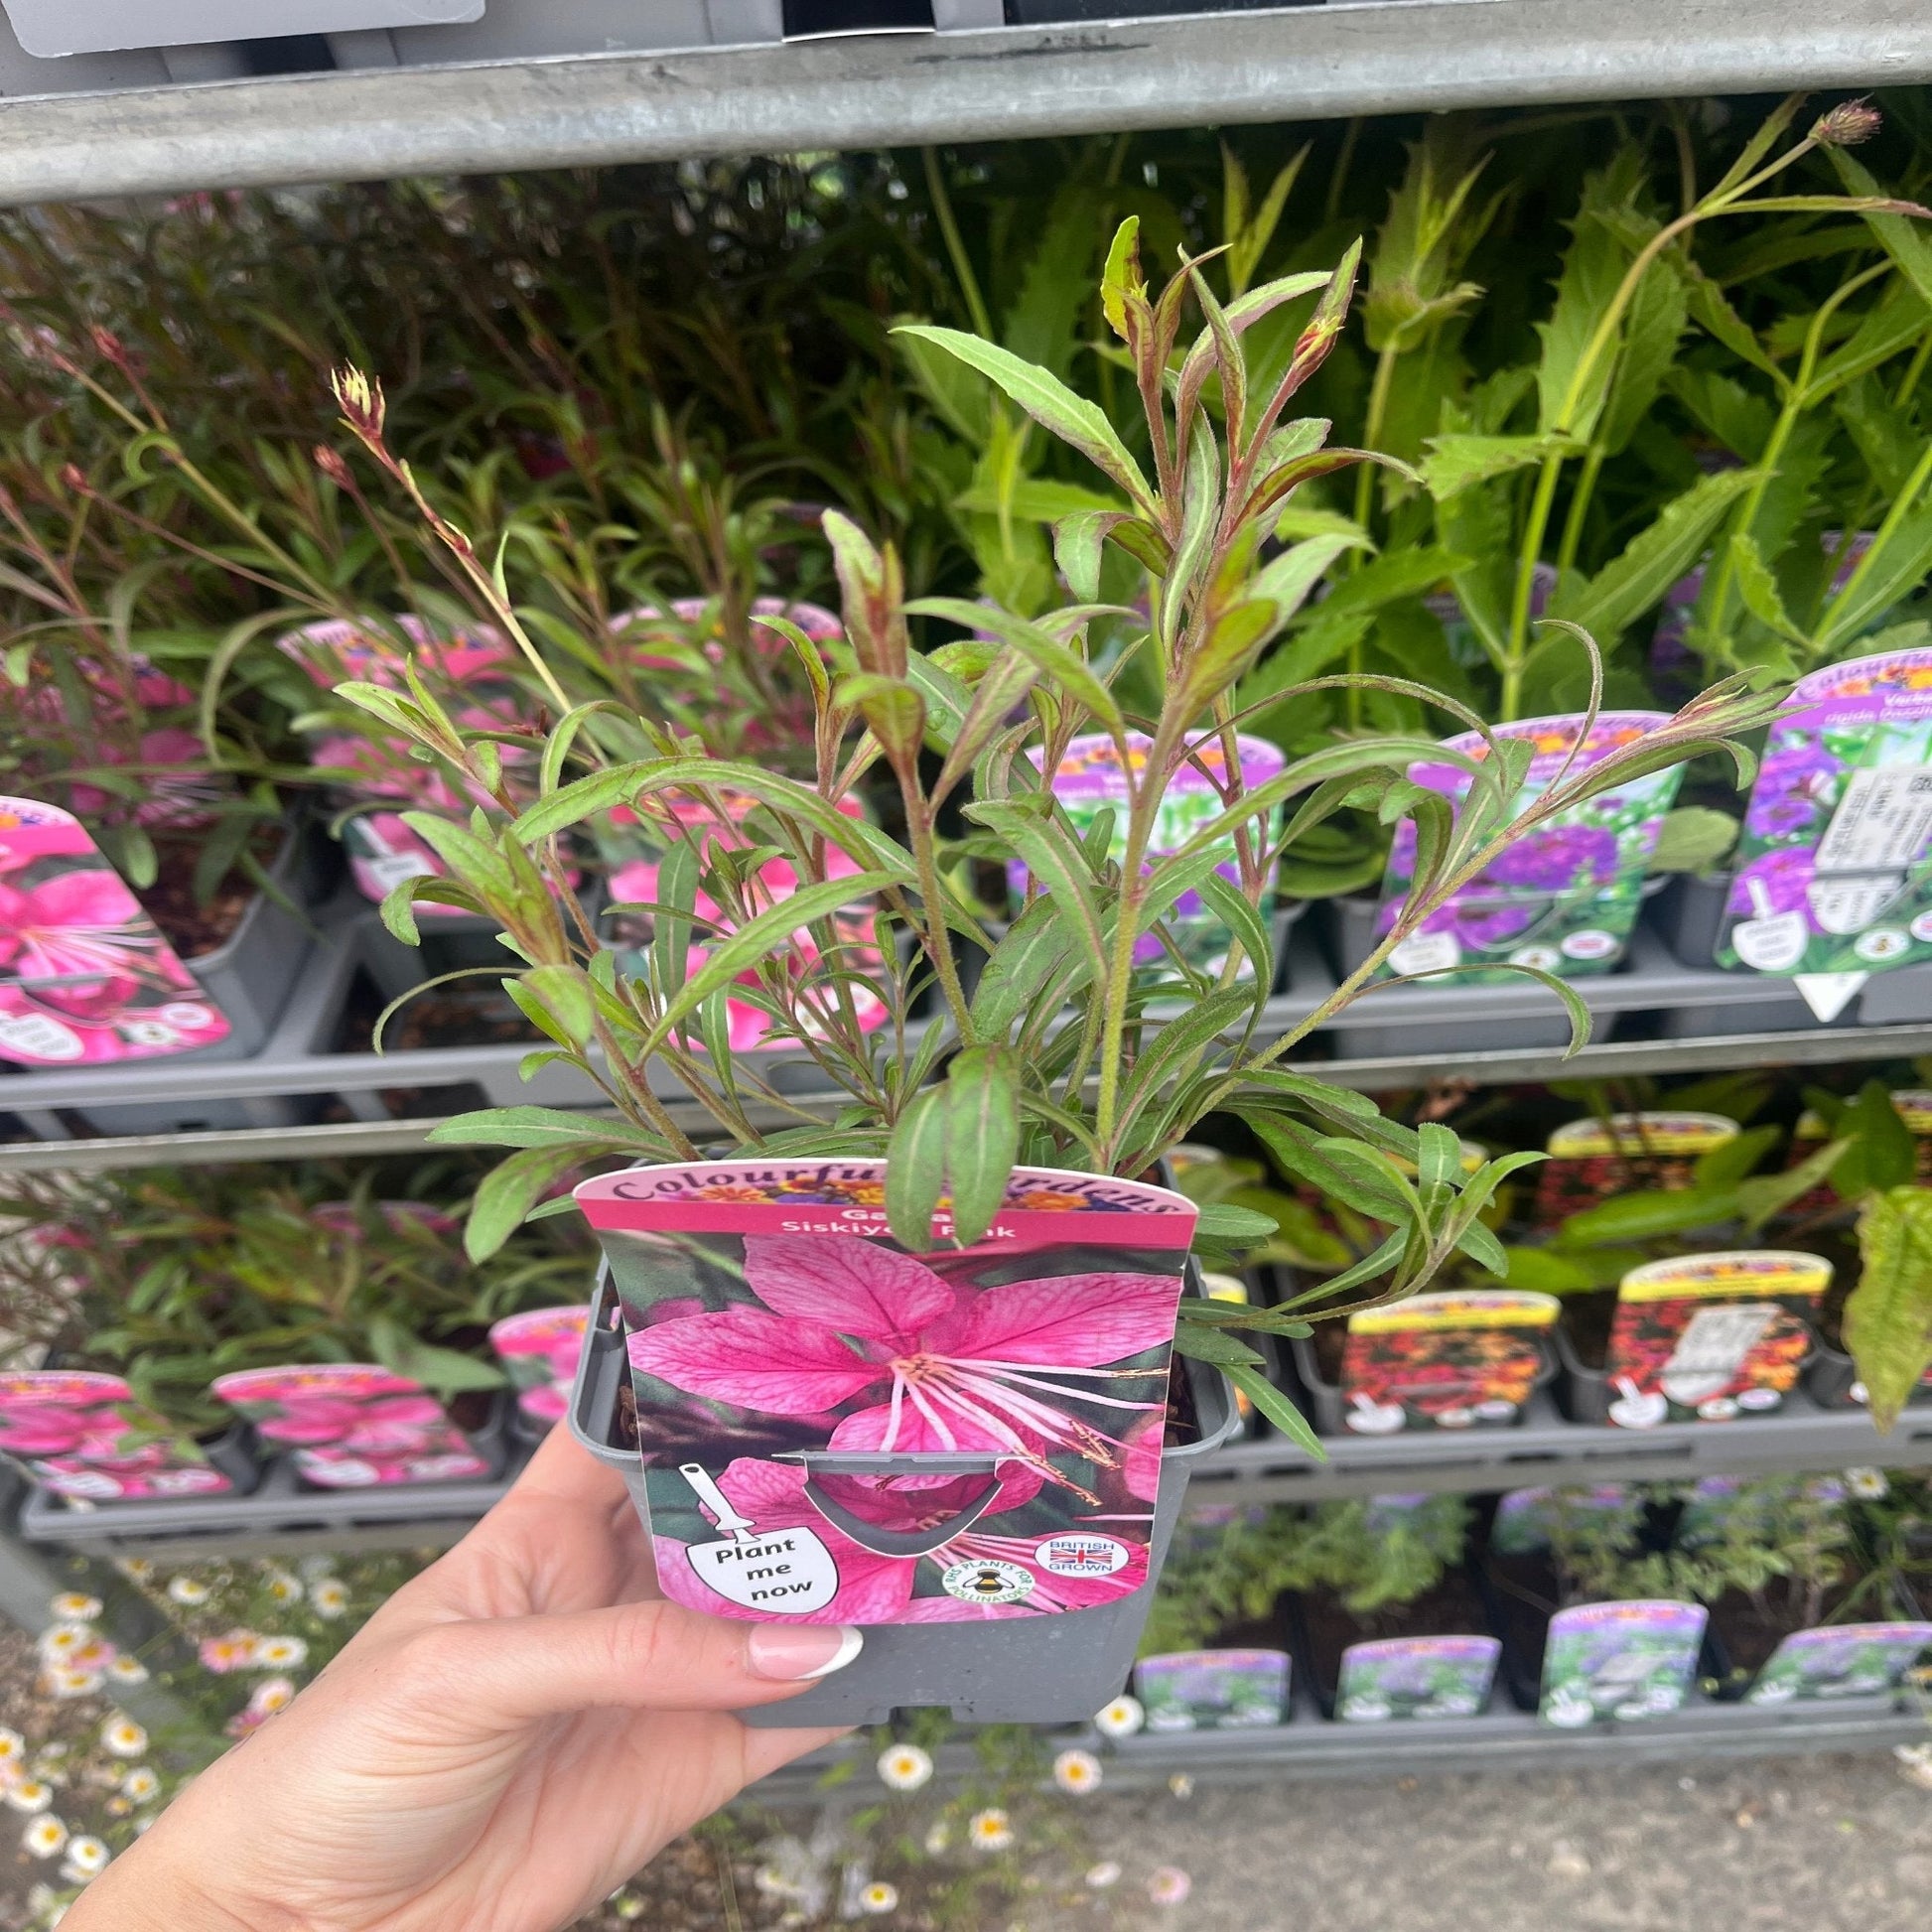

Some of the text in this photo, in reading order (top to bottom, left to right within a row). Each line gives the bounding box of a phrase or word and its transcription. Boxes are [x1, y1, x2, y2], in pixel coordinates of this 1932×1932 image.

[613, 1163, 1180, 1213] Colourfu rdens
[841, 1208, 951, 1222] Gaa
[715, 1538, 796, 1565] Plant
[1049, 1541, 1115, 1550] BRITISH
[747, 1563, 792, 1581] me
[1048, 1563, 1114, 1572] GROWN
[945, 1560, 1034, 1602] RHS PLANTS FOR POLLINATORS
[752, 1581, 813, 1600] now
